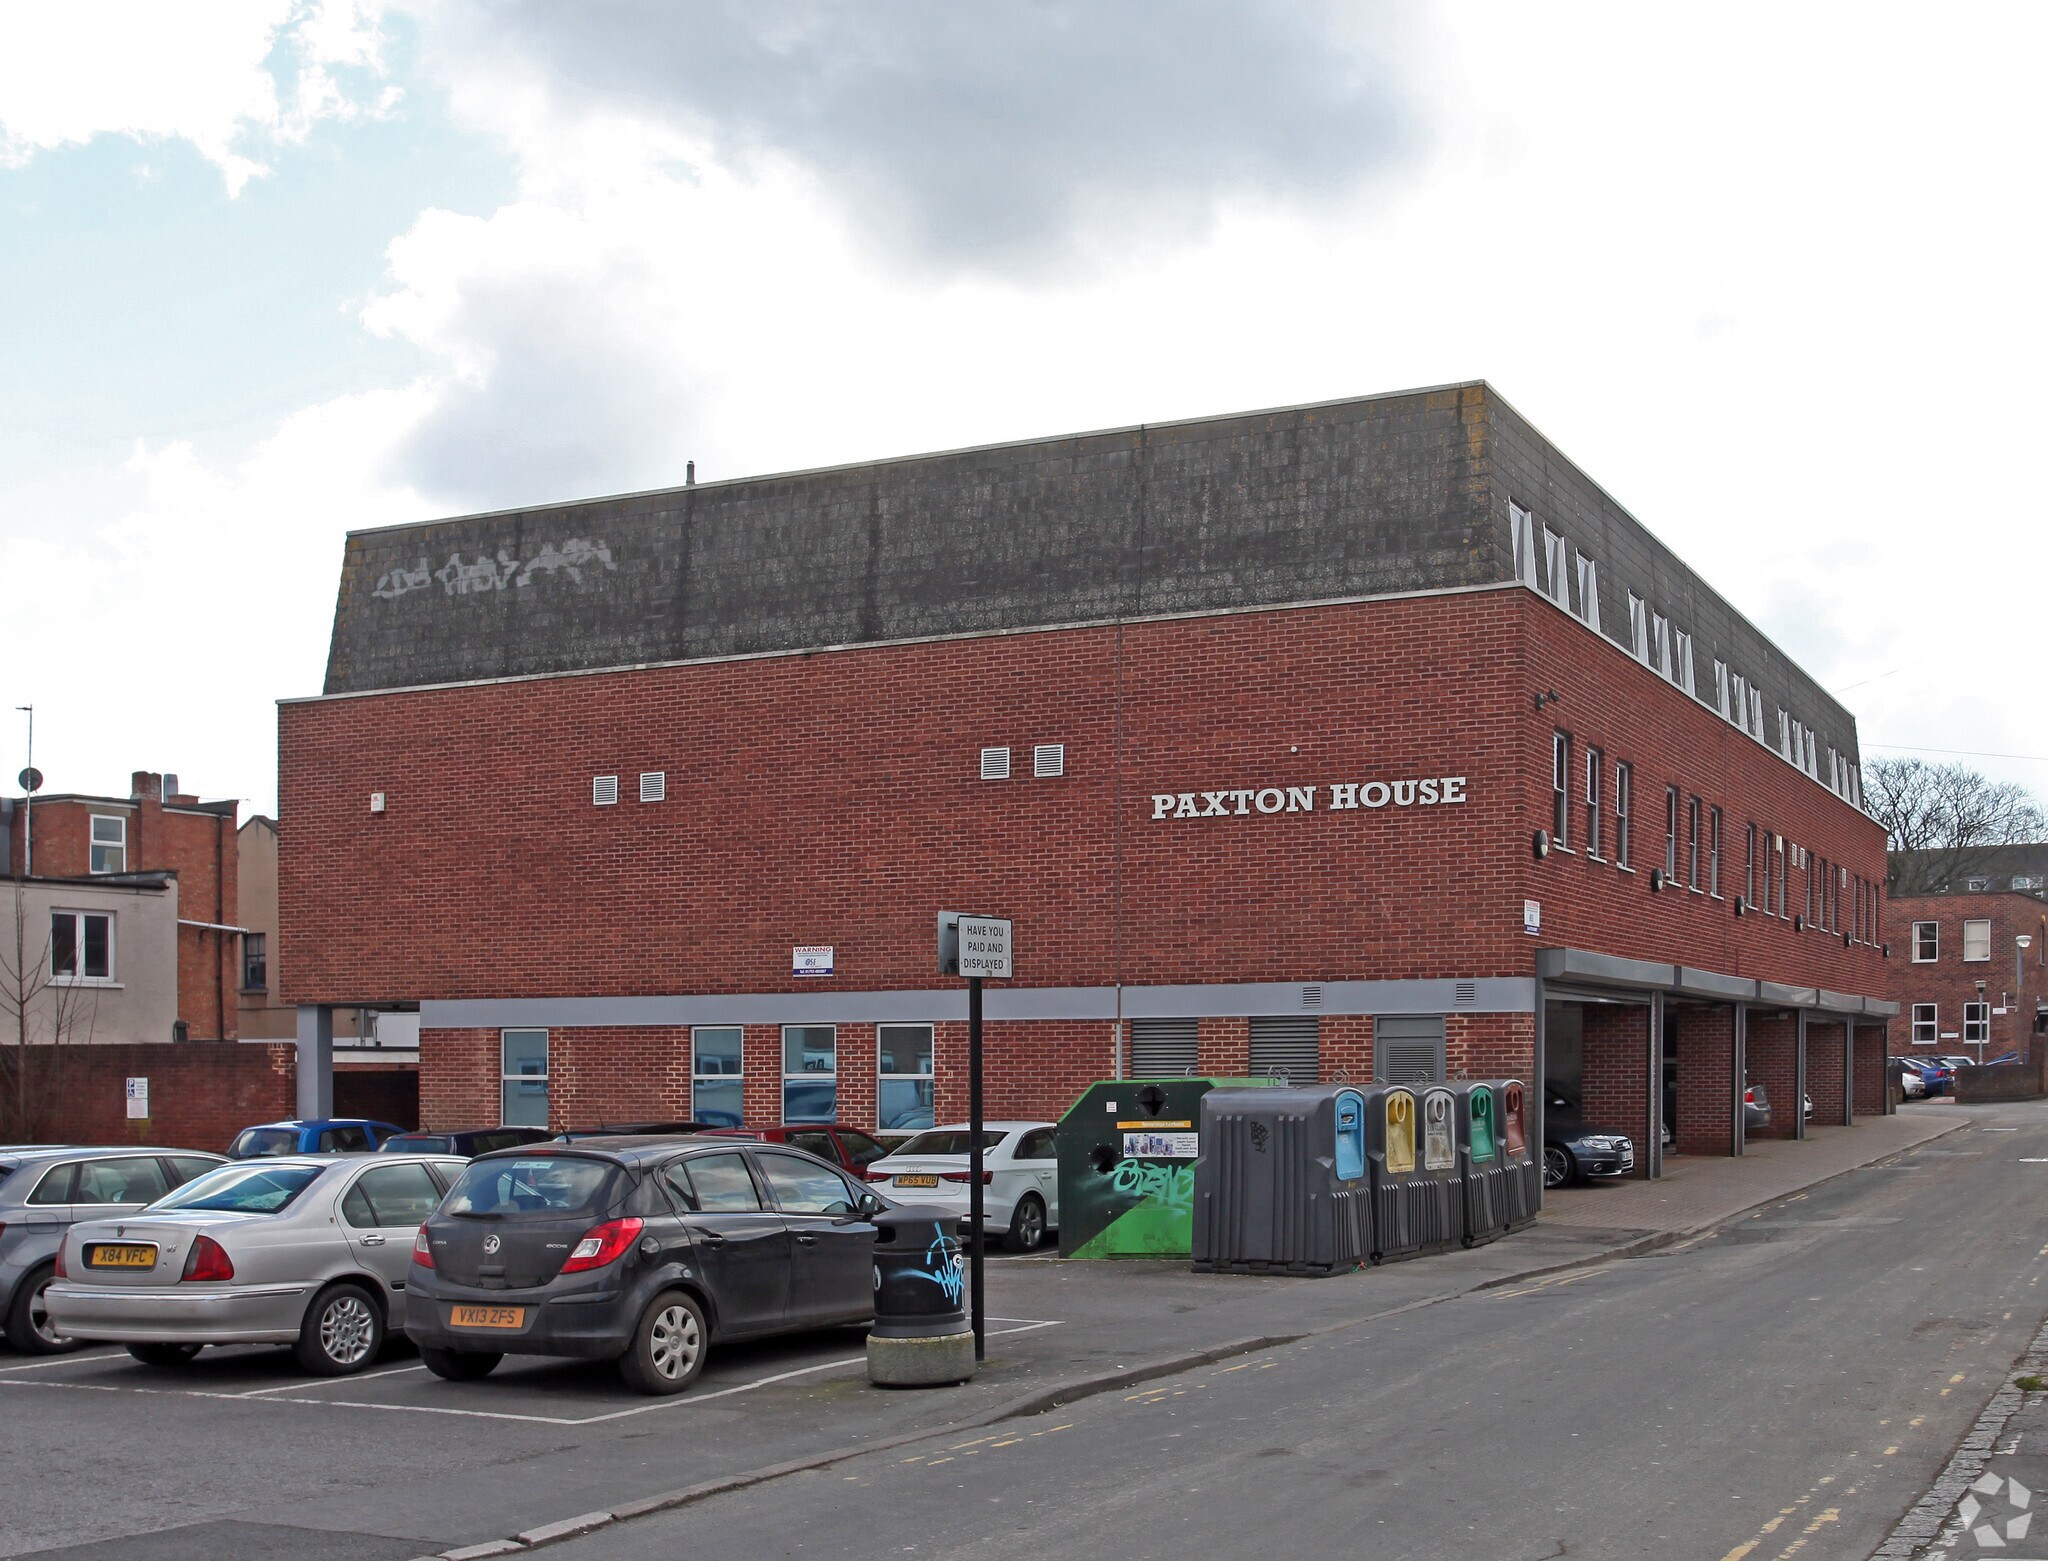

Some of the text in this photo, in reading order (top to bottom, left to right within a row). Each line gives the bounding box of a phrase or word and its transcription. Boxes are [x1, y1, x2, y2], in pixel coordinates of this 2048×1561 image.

[1151, 776, 1467, 819] PAXTON HOUSE
[967, 925, 1004, 937] HAVE YOU
[968, 941, 1003, 953] PAID AND
[963, 958, 1004, 969] DISPLAYED
[898, 1176, 936, 1184] WP65 VUB
[100, 1248, 147, 1262] X84 VFC
[460, 1308, 516, 1324] VX13 ZFS
